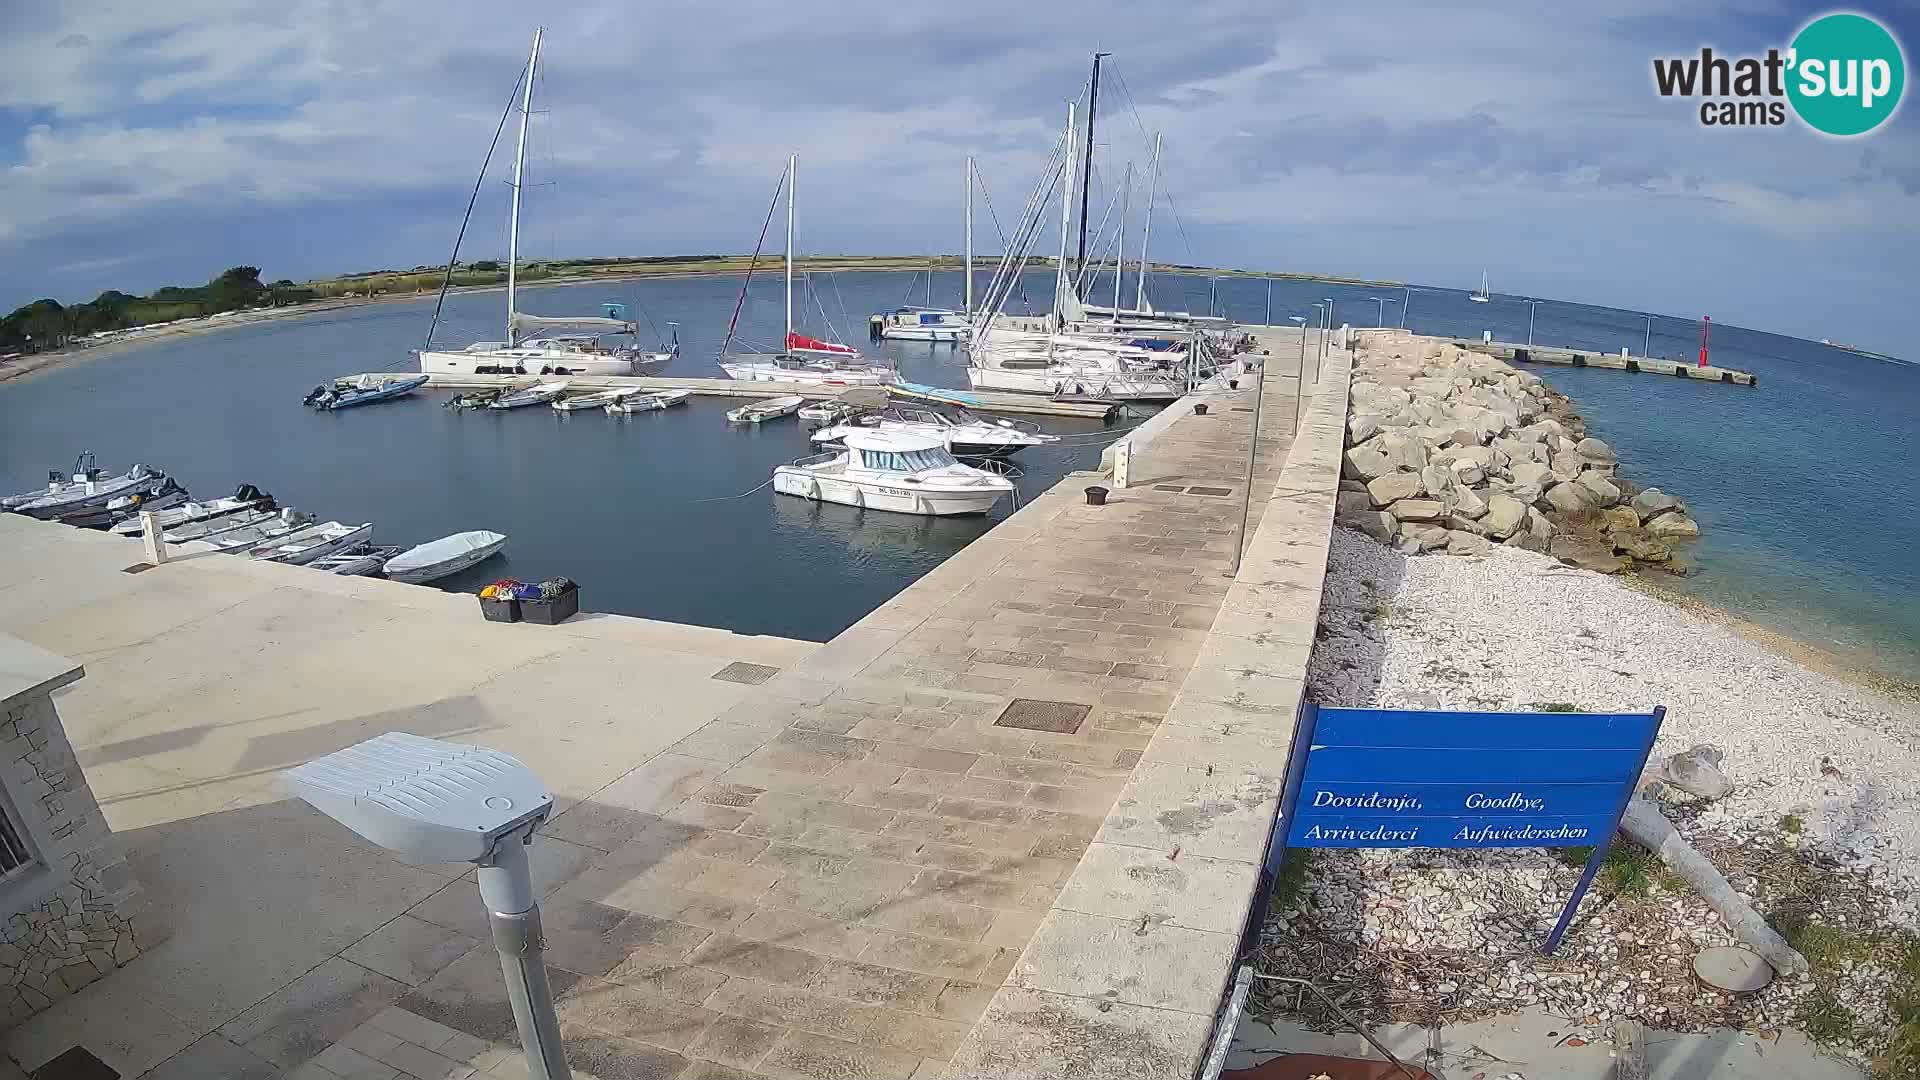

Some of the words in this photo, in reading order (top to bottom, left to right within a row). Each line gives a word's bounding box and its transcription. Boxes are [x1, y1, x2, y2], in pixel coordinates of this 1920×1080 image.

[1465, 792, 1545, 812] Goodbye,
[1303, 824, 1419, 841] Arrivederci
[1453, 823, 1588, 843] Aufwiedersehen
